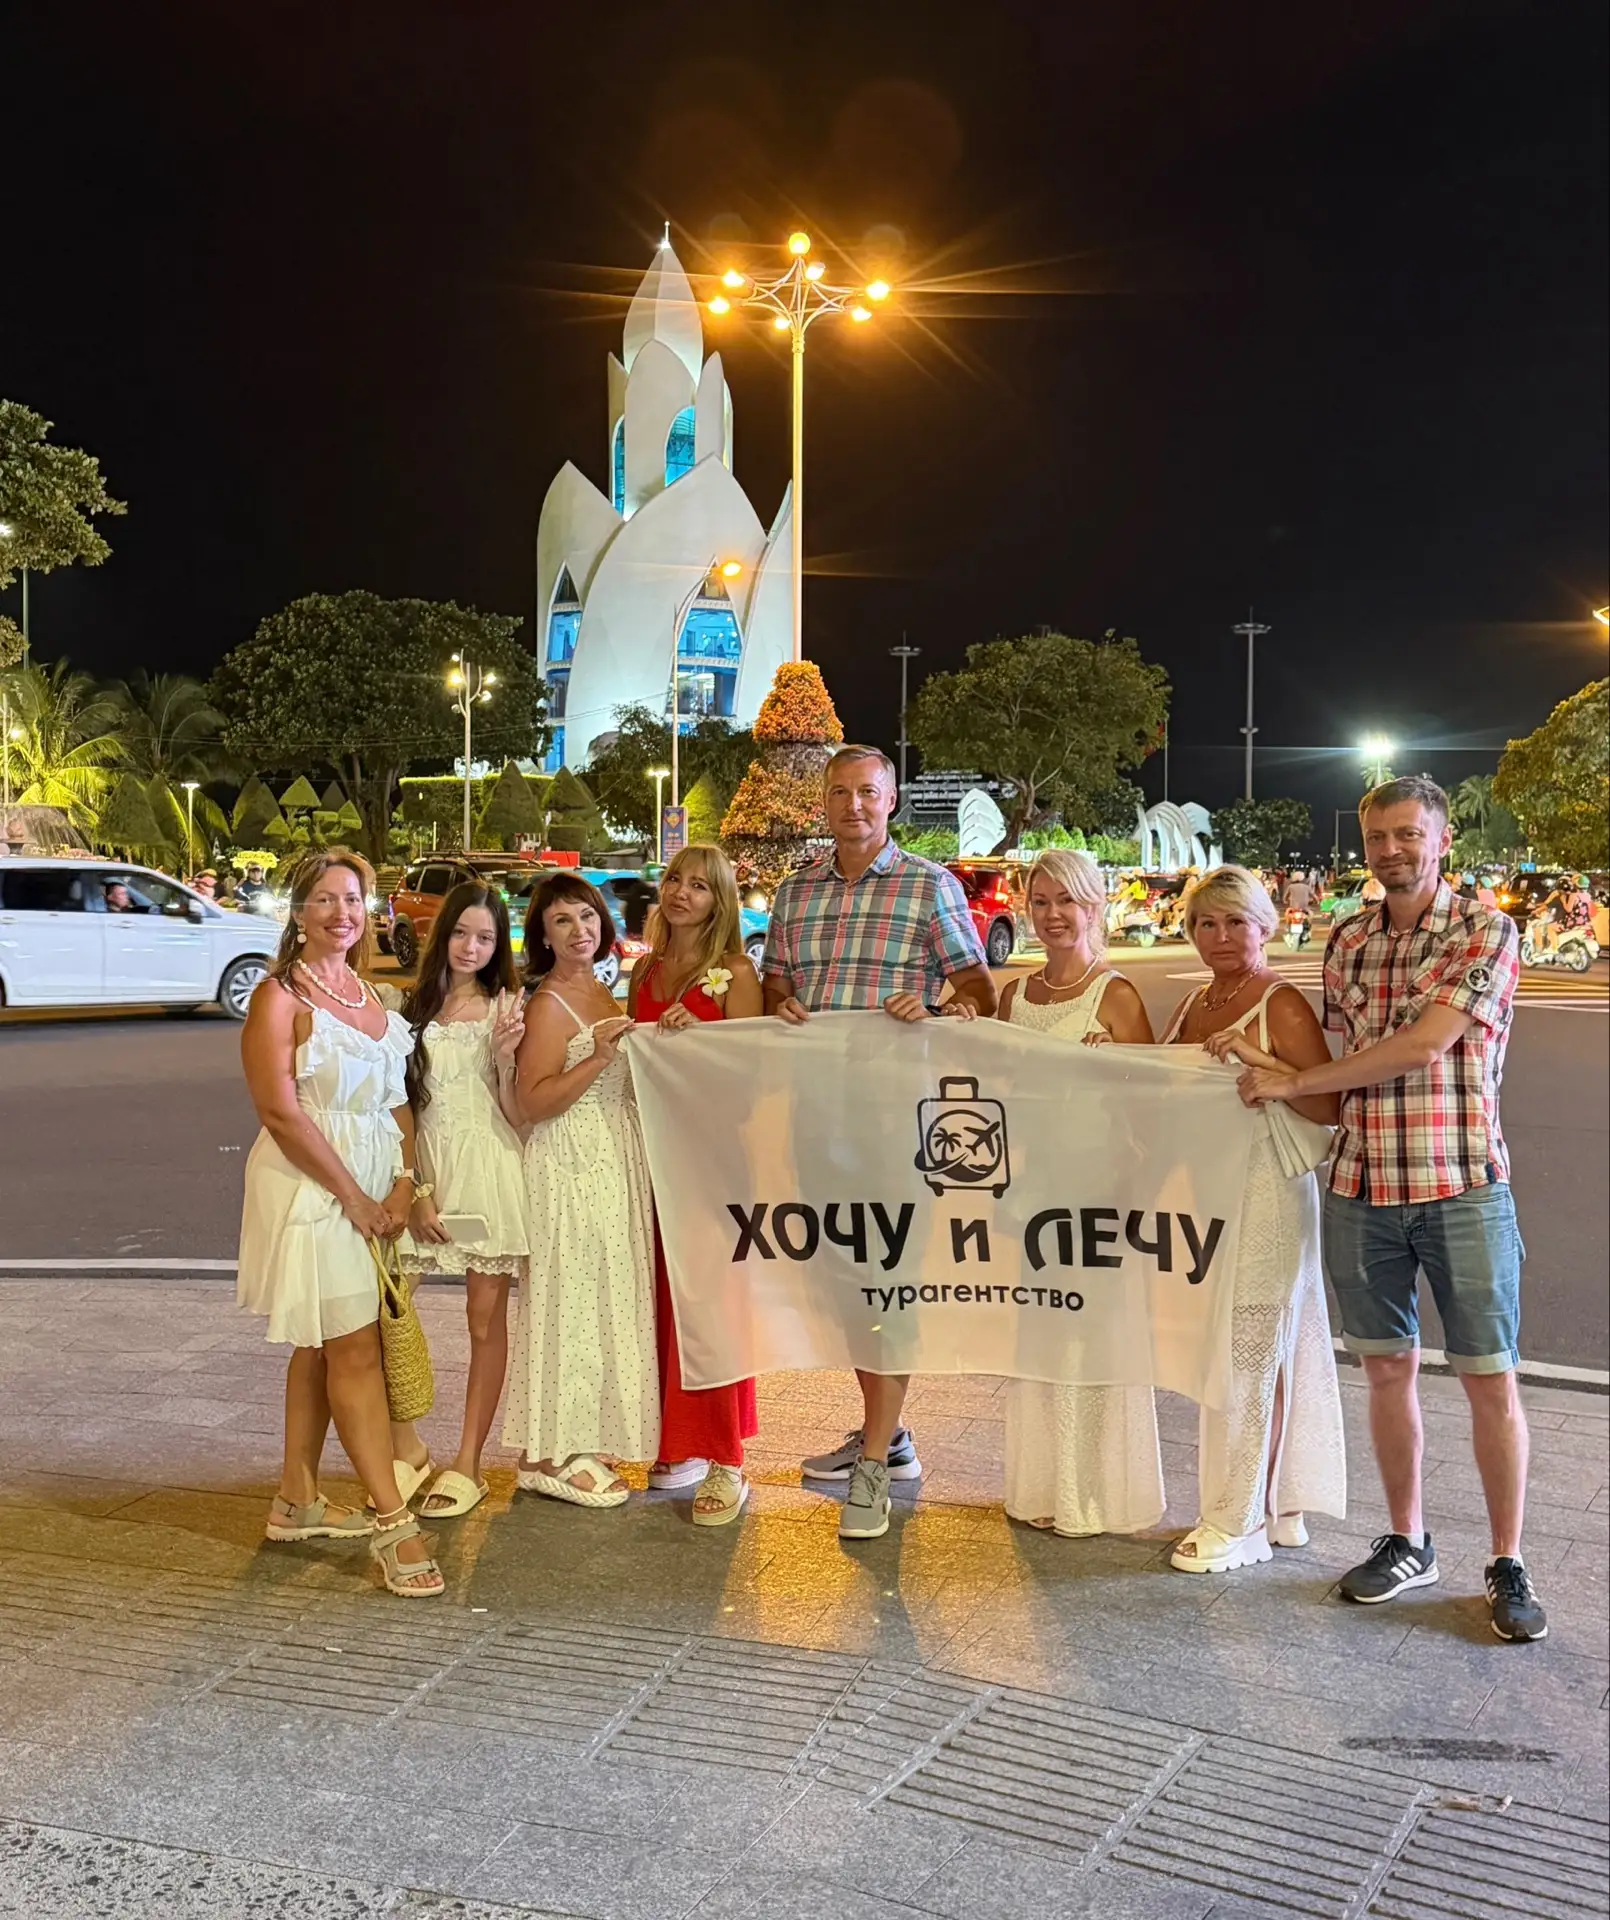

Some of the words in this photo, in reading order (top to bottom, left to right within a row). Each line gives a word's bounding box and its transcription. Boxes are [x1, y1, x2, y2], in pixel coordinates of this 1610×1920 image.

[726, 1203, 916, 1271] ХОЧУ
[1024, 1207, 1226, 1285] ЛЕЧУ
[861, 1283, 1084, 1312] турагентство
